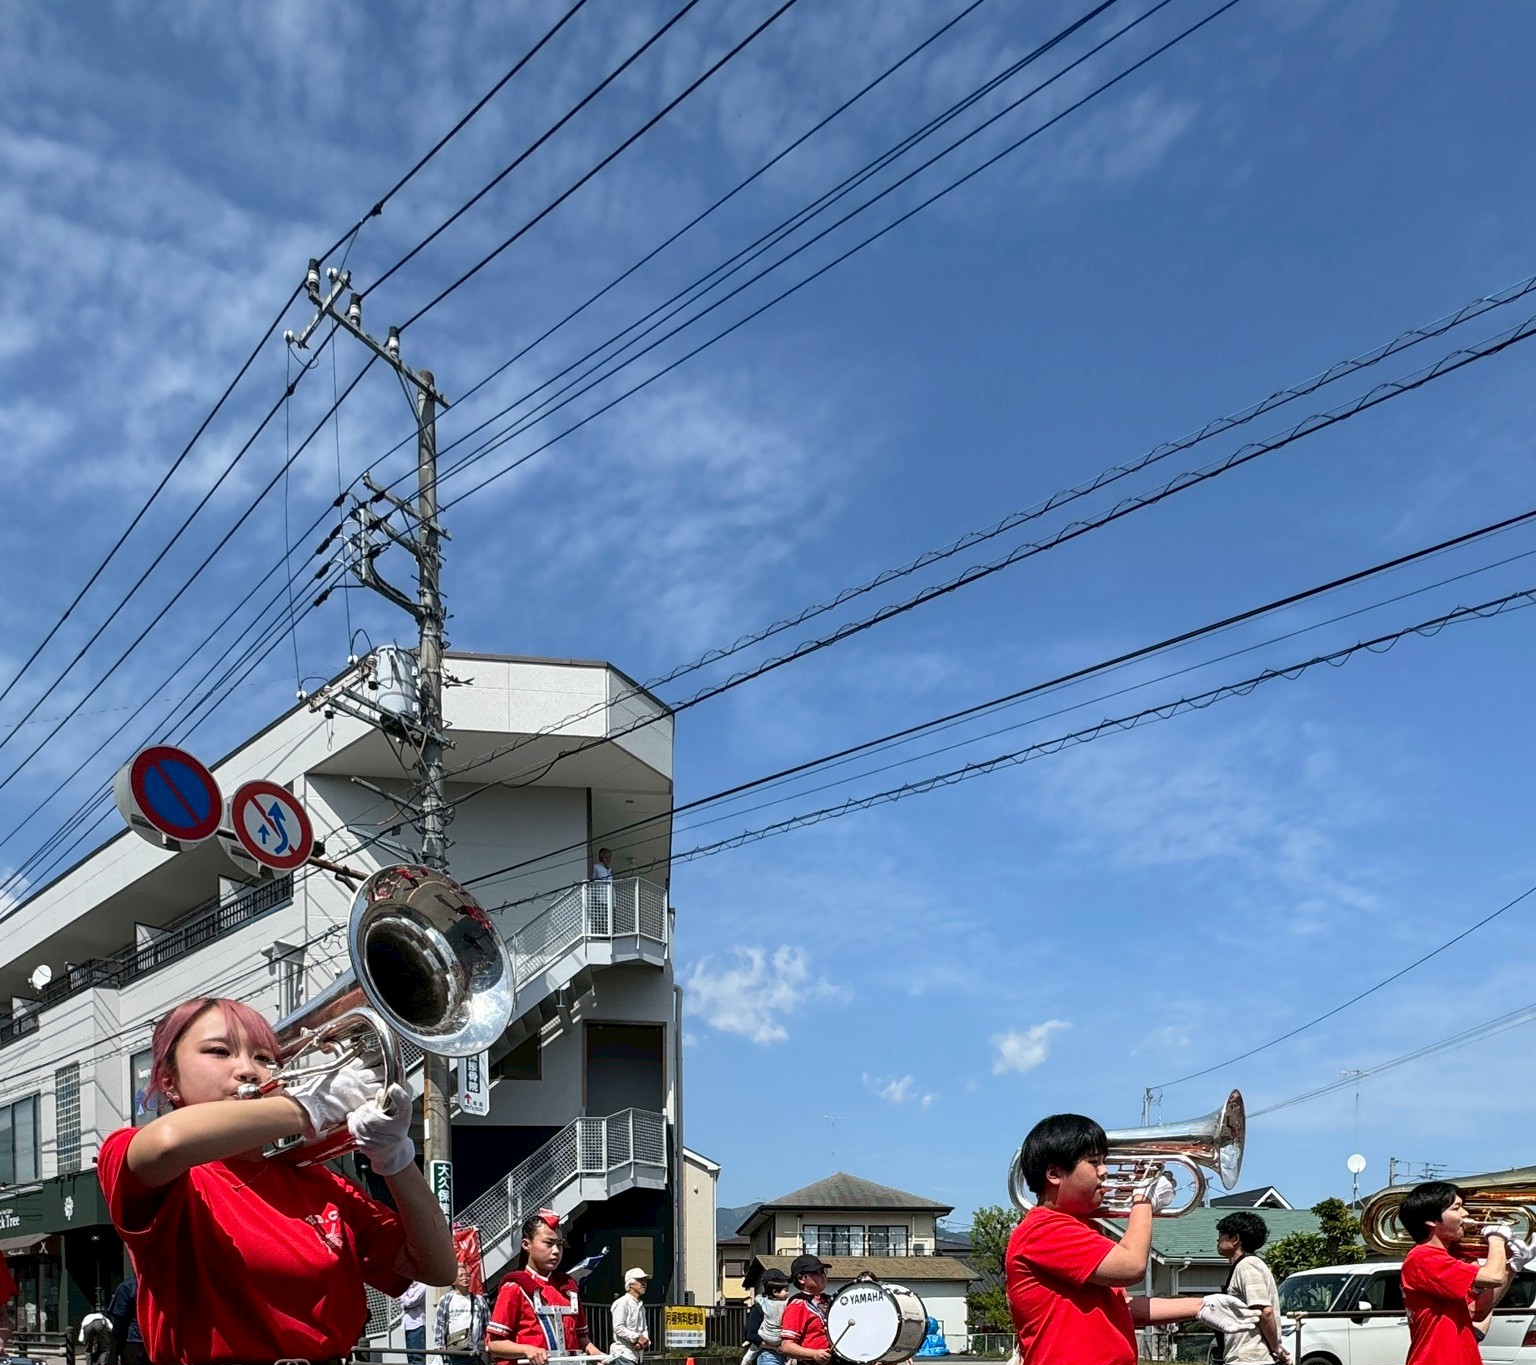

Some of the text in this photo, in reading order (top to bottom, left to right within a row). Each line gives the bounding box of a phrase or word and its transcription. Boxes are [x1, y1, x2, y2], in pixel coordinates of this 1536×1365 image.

[6, 1214, 20, 1228] Tree
[849, 1291, 884, 1305] YAMAHA
[665, 1311, 704, 1326] 月極有料駐車場
